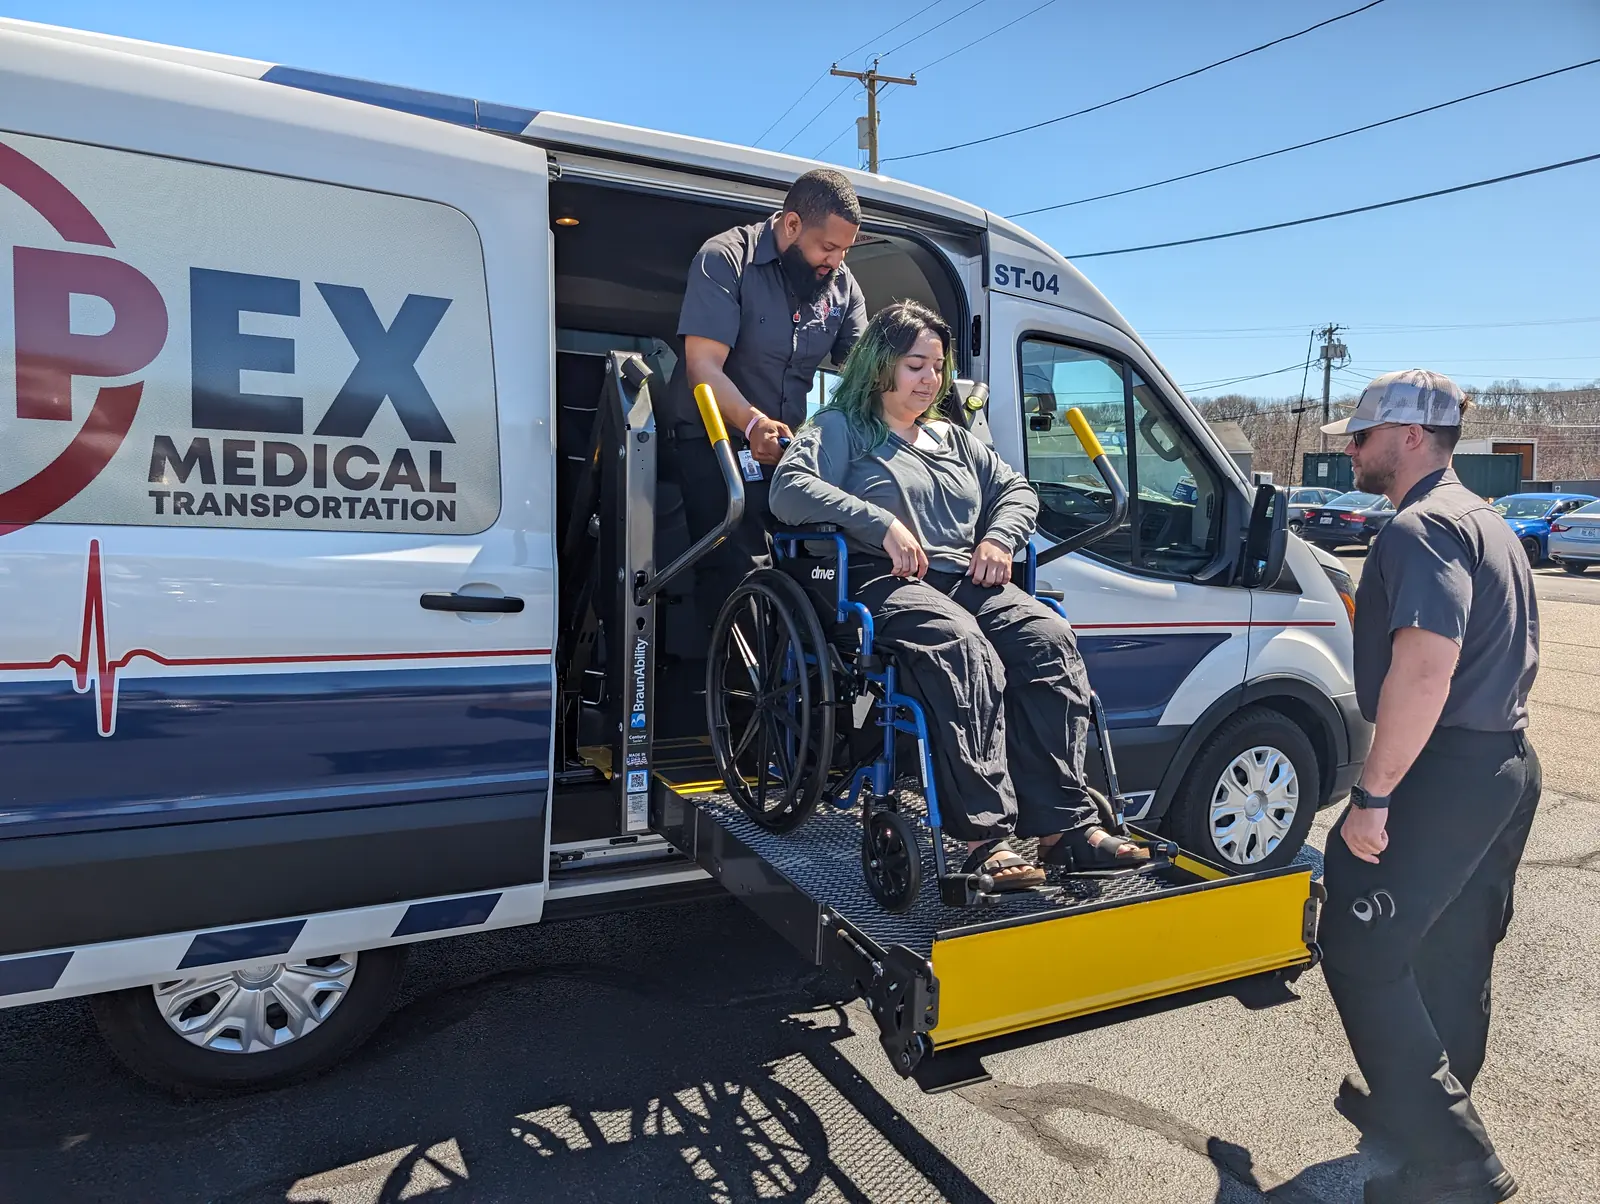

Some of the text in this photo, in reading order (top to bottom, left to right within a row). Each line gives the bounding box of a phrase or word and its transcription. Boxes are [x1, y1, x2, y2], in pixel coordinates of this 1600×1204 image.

[994, 263, 1060, 296] ST-04
[148, 435, 457, 494] MEDICAL
[148, 490, 457, 522] TRANSPORTATION
[811, 565, 835, 580] drive
[633, 638, 648, 712] BraunAbility
